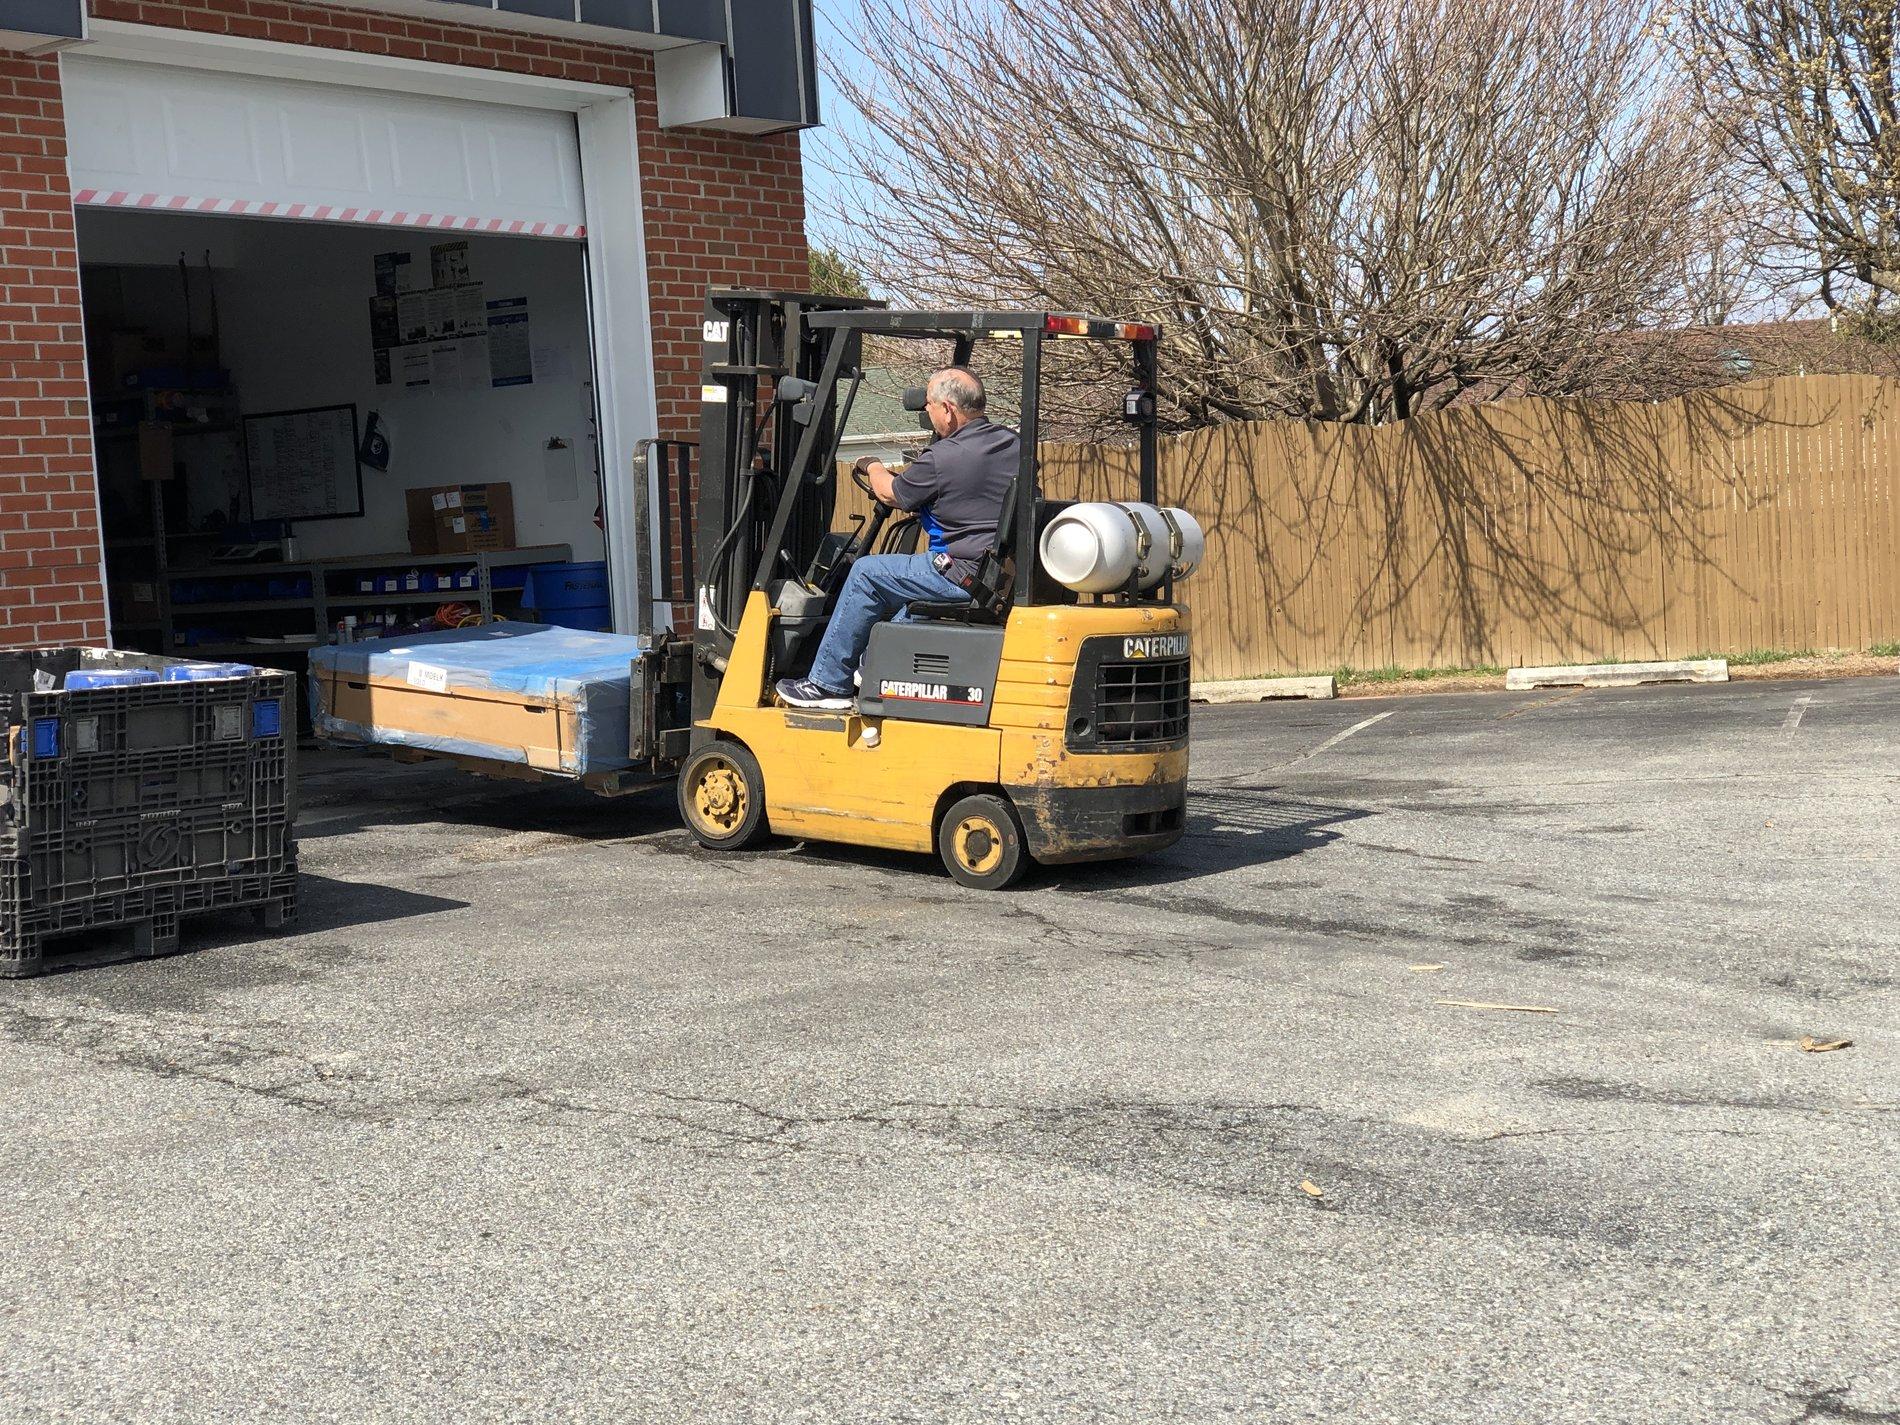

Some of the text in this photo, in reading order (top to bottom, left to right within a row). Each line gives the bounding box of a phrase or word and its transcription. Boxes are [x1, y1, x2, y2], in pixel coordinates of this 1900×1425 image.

[703, 321, 729, 342] CAT
[1123, 635, 1189, 658] CATERPILL
[881, 680, 983, 702] CATERPILLAR 30
